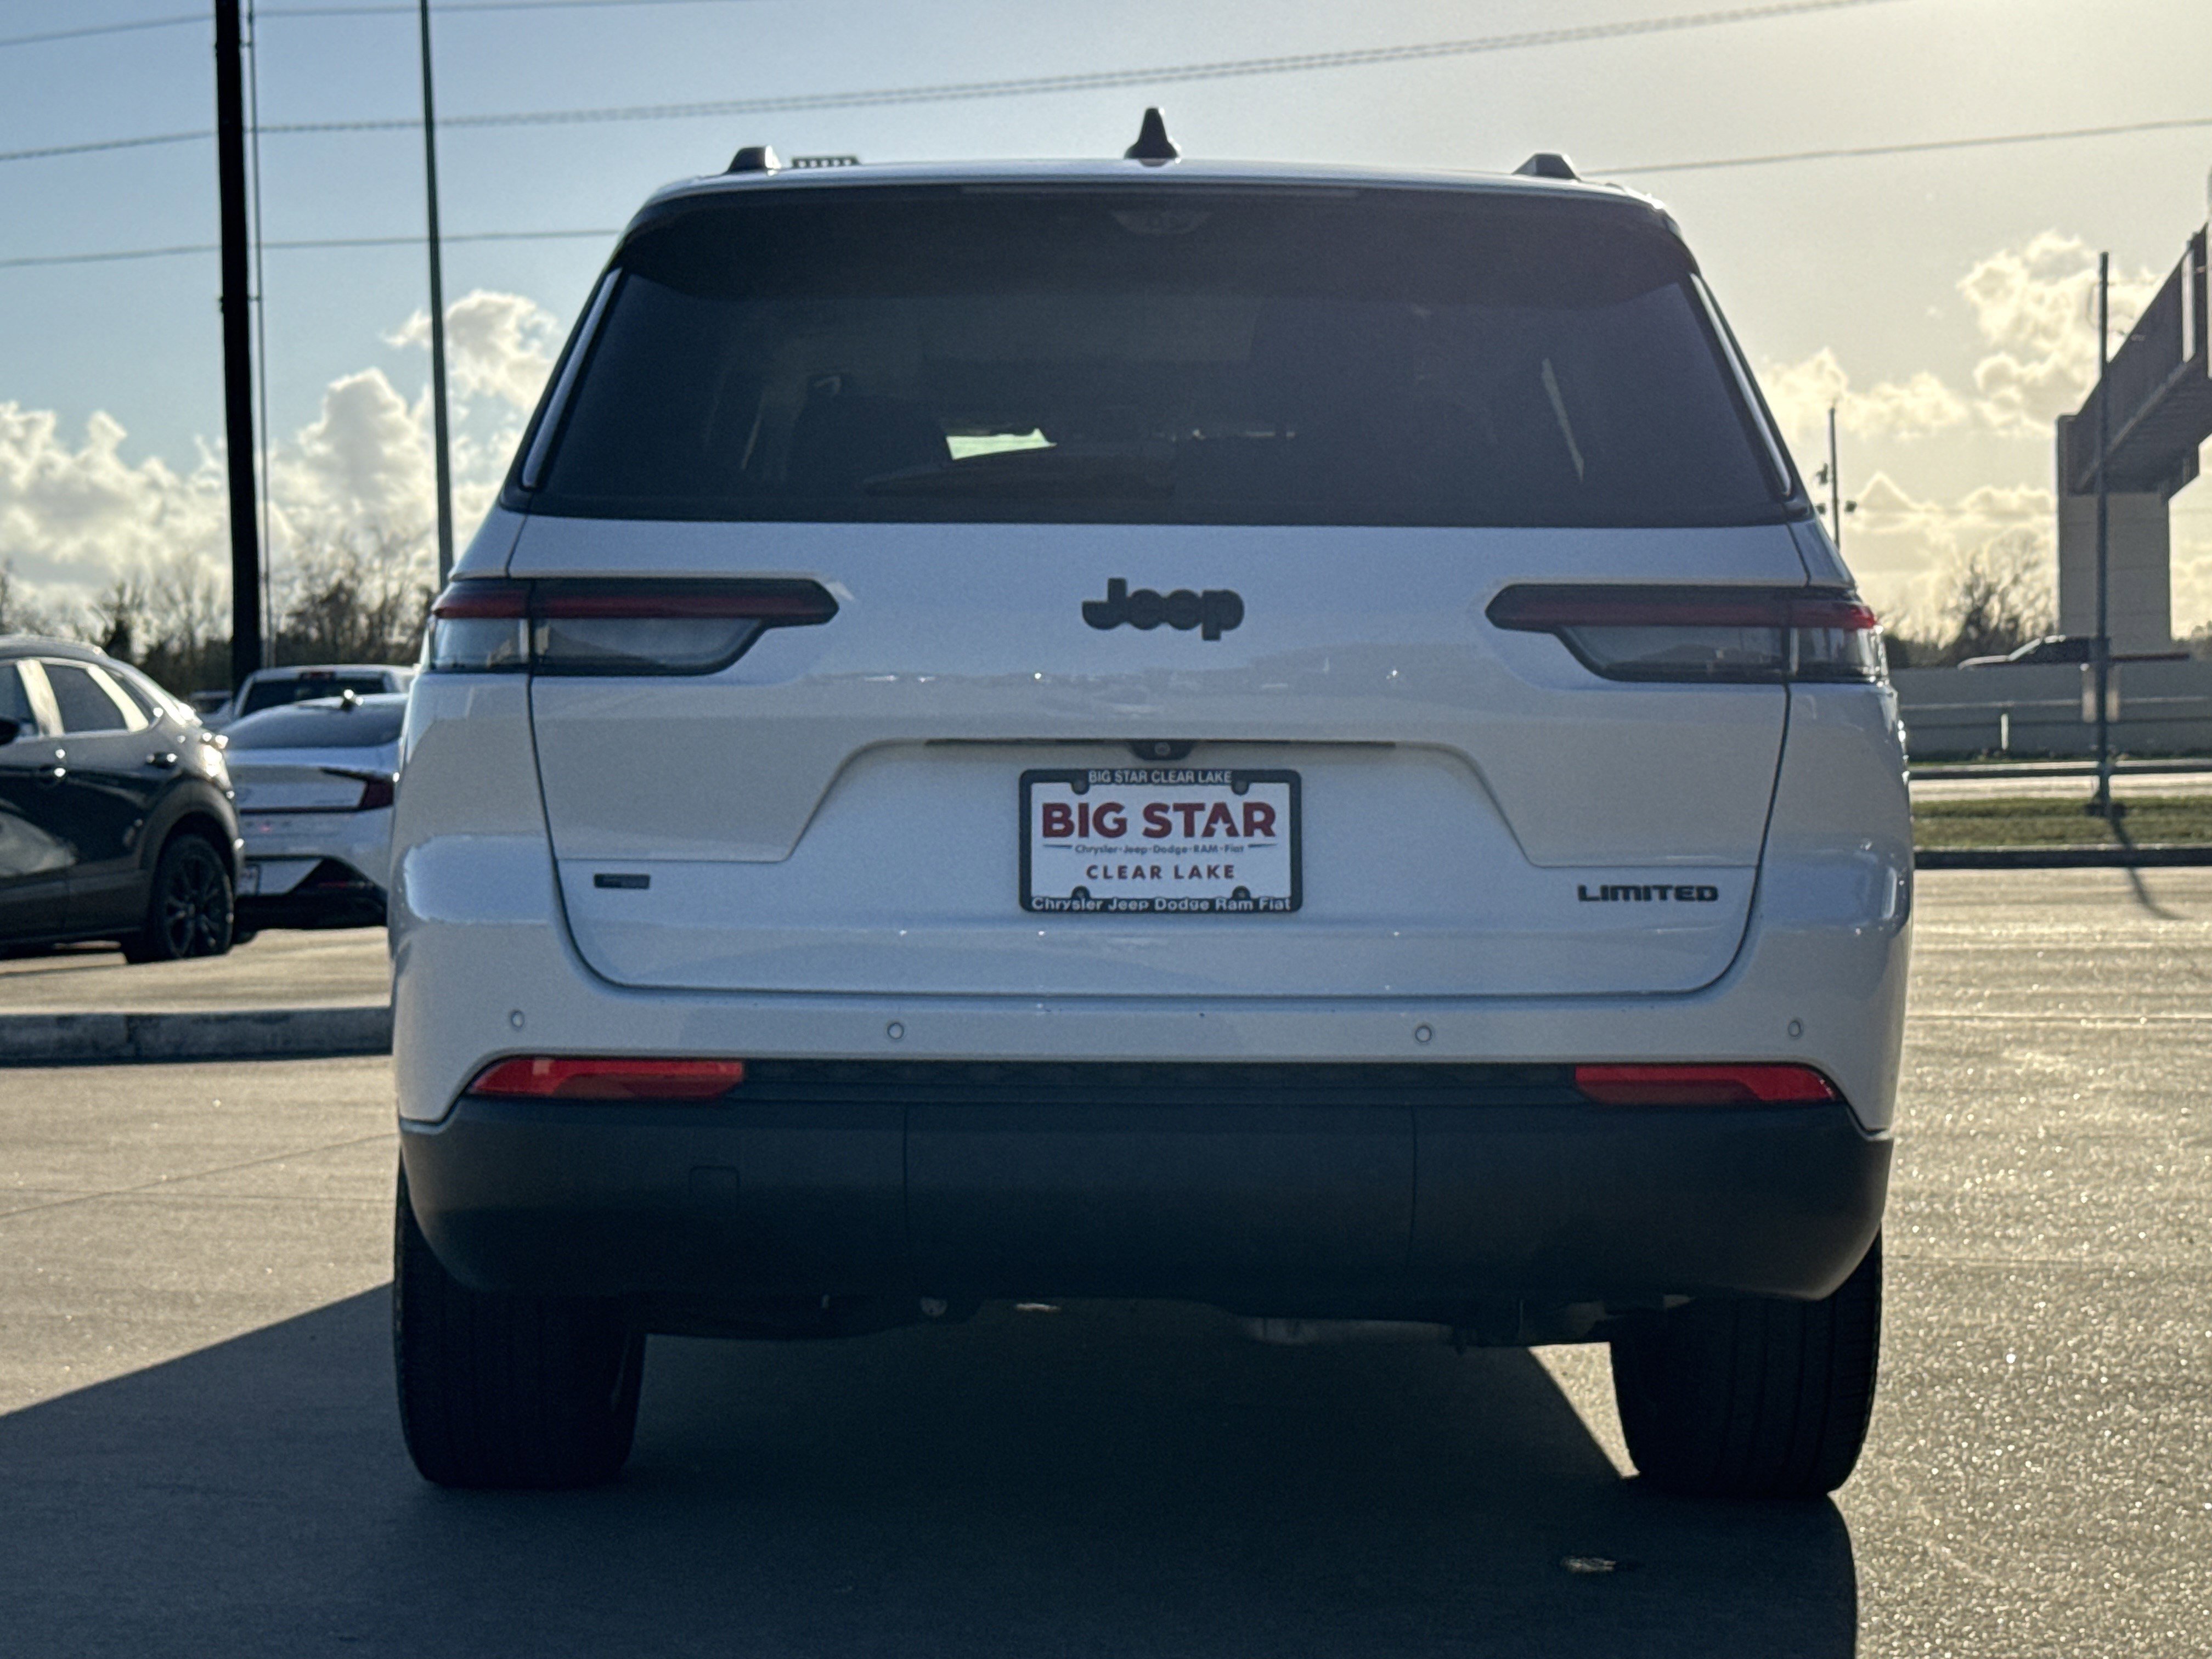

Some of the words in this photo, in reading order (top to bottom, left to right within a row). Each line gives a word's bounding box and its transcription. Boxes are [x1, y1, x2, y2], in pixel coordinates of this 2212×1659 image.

[1082, 578, 1244, 641] Jeep
[1088, 770, 1111, 783] BIG
[1114, 770, 1148, 783] STAR
[1152, 770, 1195, 784] CLEAR
[1198, 770, 1232, 783] LAKE
[1042, 802, 1128, 838] BIG
[1142, 802, 1276, 838] STAR
[1086, 865, 1162, 879] CLEAR
[1175, 865, 1234, 879] LAKE
[1578, 884, 1718, 901] LIMITED
[1031, 898, 1103, 911] Chrysler
[1108, 898, 1149, 911] Jeep
[1154, 898, 1210, 911] Dodge
[1215, 898, 1254, 911] Ram
[1259, 896, 1290, 911] Fiat
